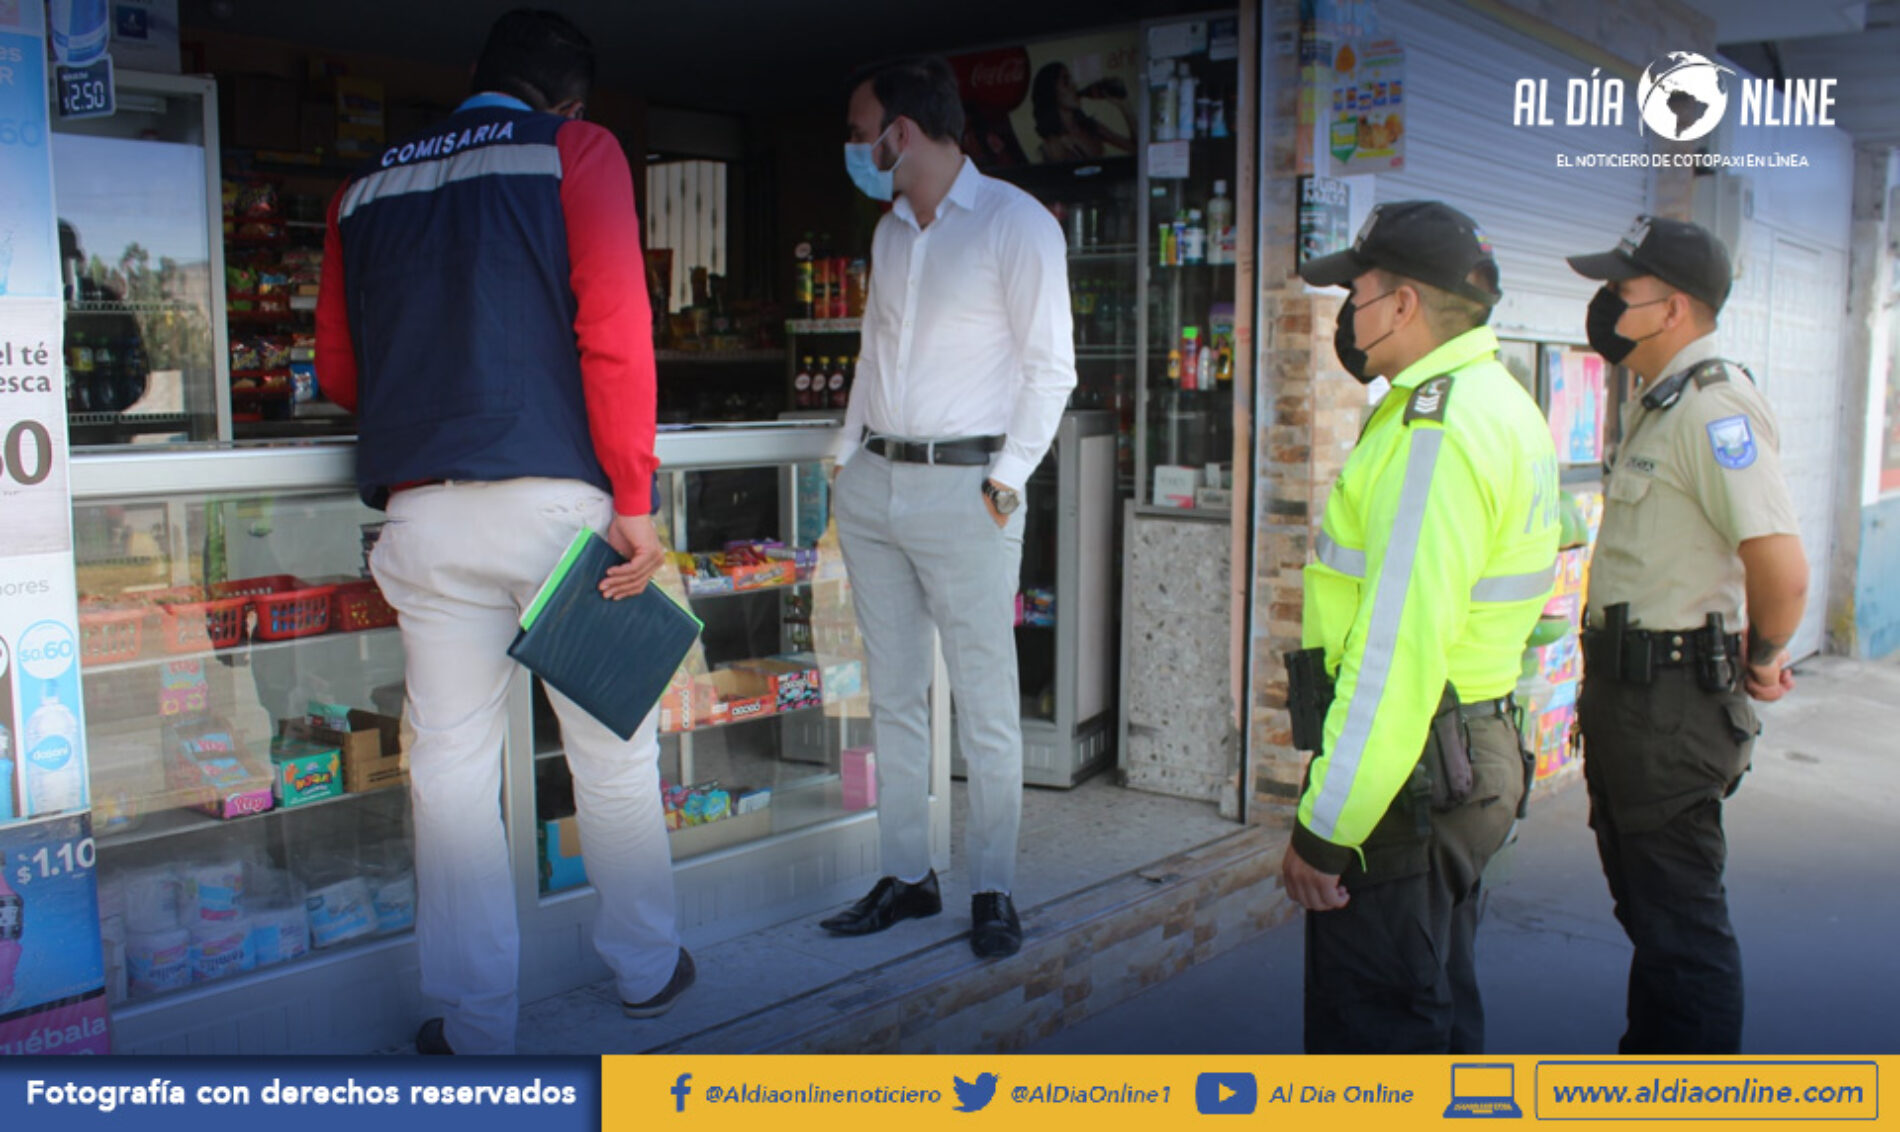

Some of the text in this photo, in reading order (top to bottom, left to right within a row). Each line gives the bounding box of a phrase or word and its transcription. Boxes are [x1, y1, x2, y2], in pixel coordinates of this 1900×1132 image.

[381, 120, 515, 167] COMISARIA
[21, 341, 49, 366] té
[0, 579, 50, 597] ores
